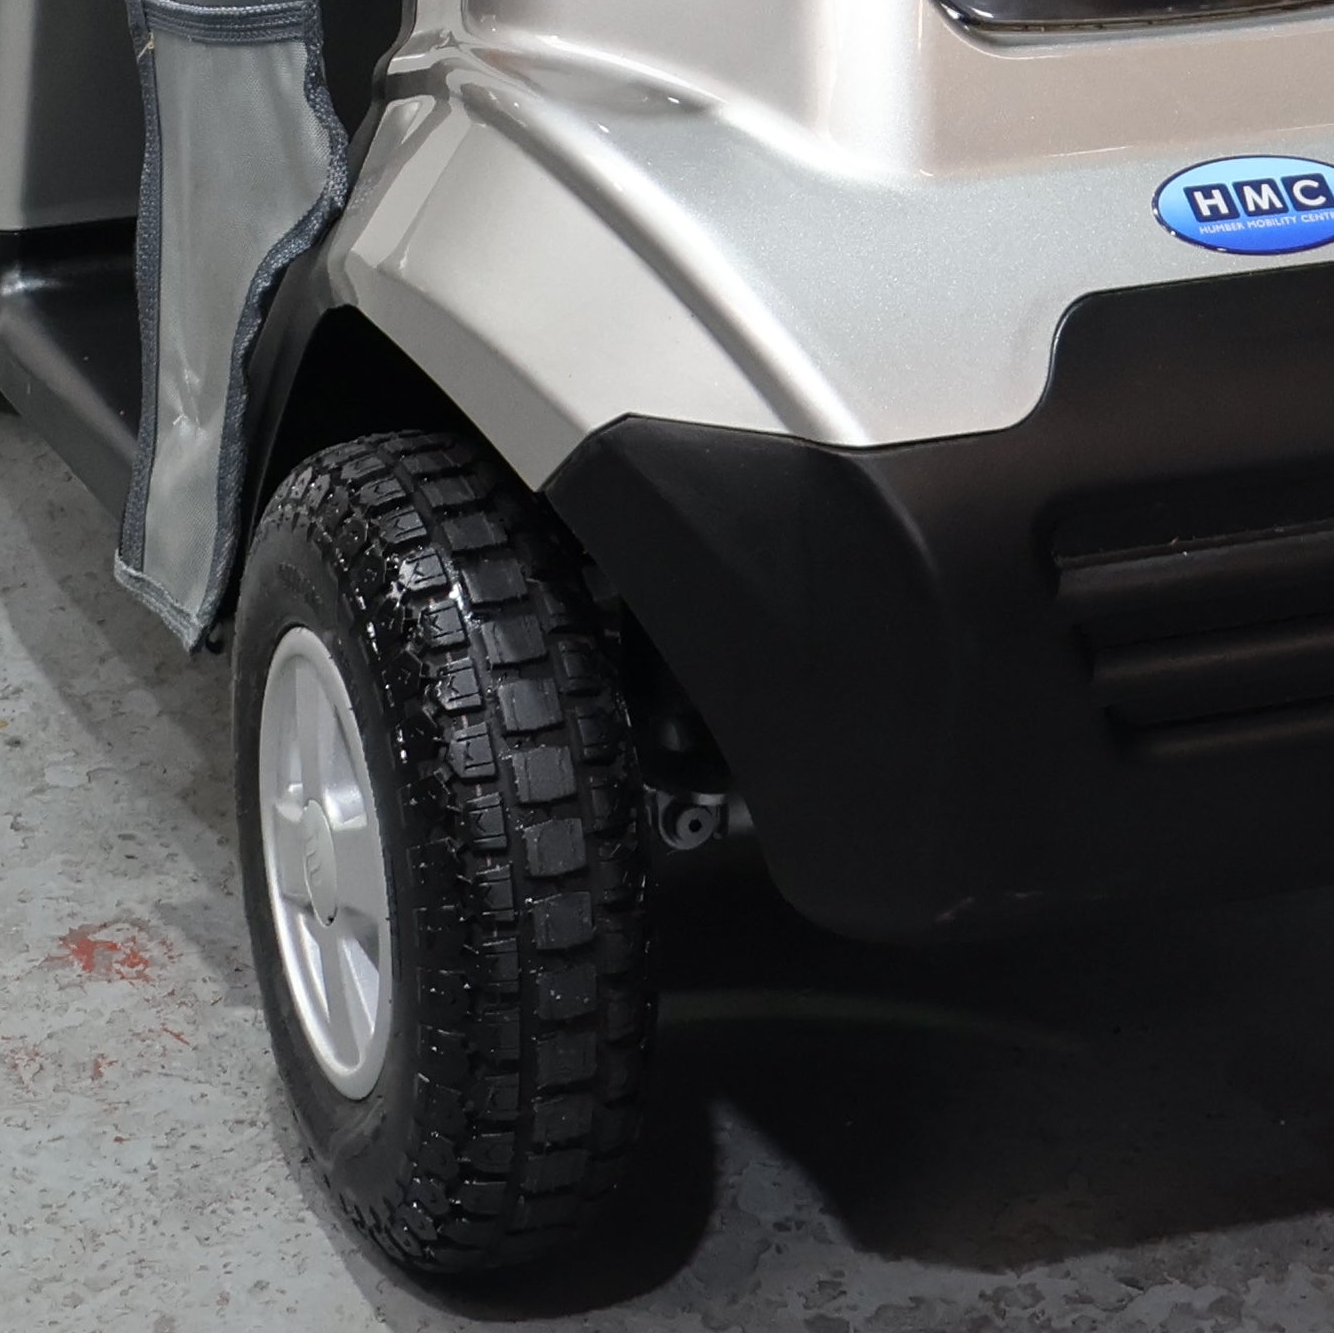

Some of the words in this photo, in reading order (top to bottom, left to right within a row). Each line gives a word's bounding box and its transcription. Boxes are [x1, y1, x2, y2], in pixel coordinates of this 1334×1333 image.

[1193, 179, 1327, 217] HMC
[1198, 222, 1245, 235] HUMBER
[1247, 215, 1297, 229] MOBILITY
